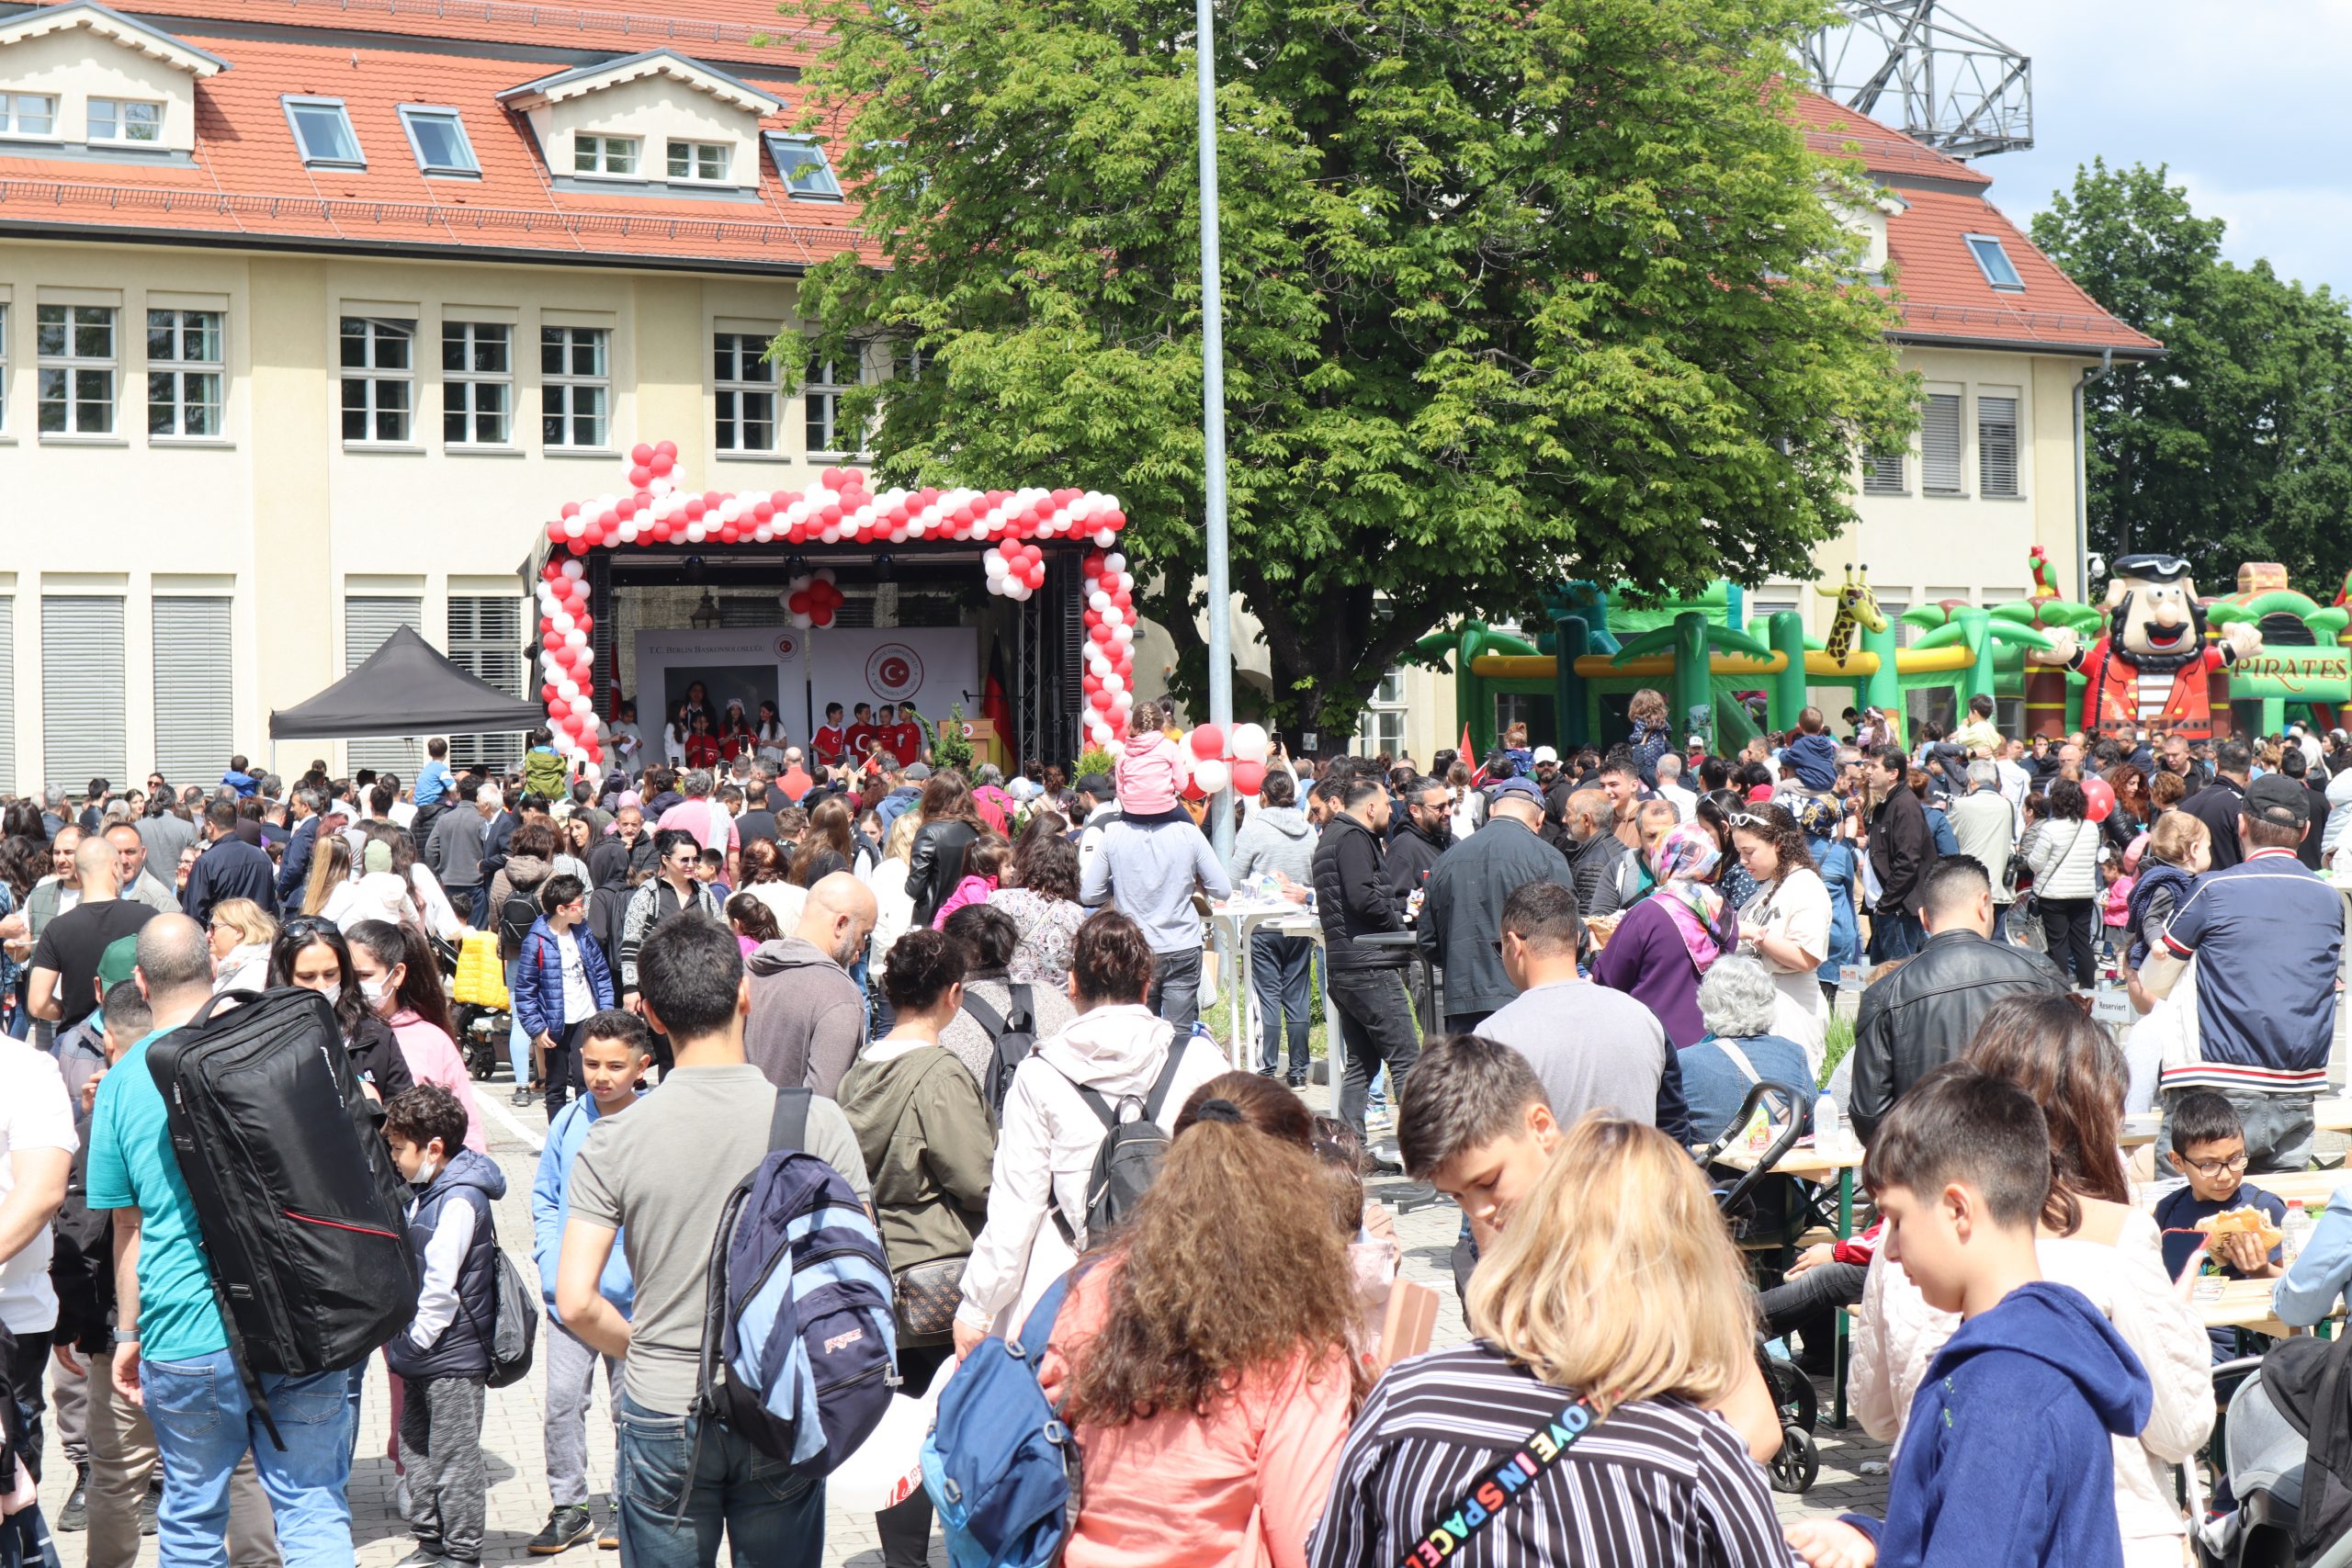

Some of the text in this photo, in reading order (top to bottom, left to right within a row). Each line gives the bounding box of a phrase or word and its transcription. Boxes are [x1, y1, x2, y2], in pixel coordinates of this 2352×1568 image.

[648, 646, 663, 654] T.C.
[2233, 657, 2348, 692] PIRATES
[2099, 1000, 2126, 1011] Reserviert
[1497, 1451, 1538, 1493] IN
[1418, 1482, 1504, 1568] SPACE
